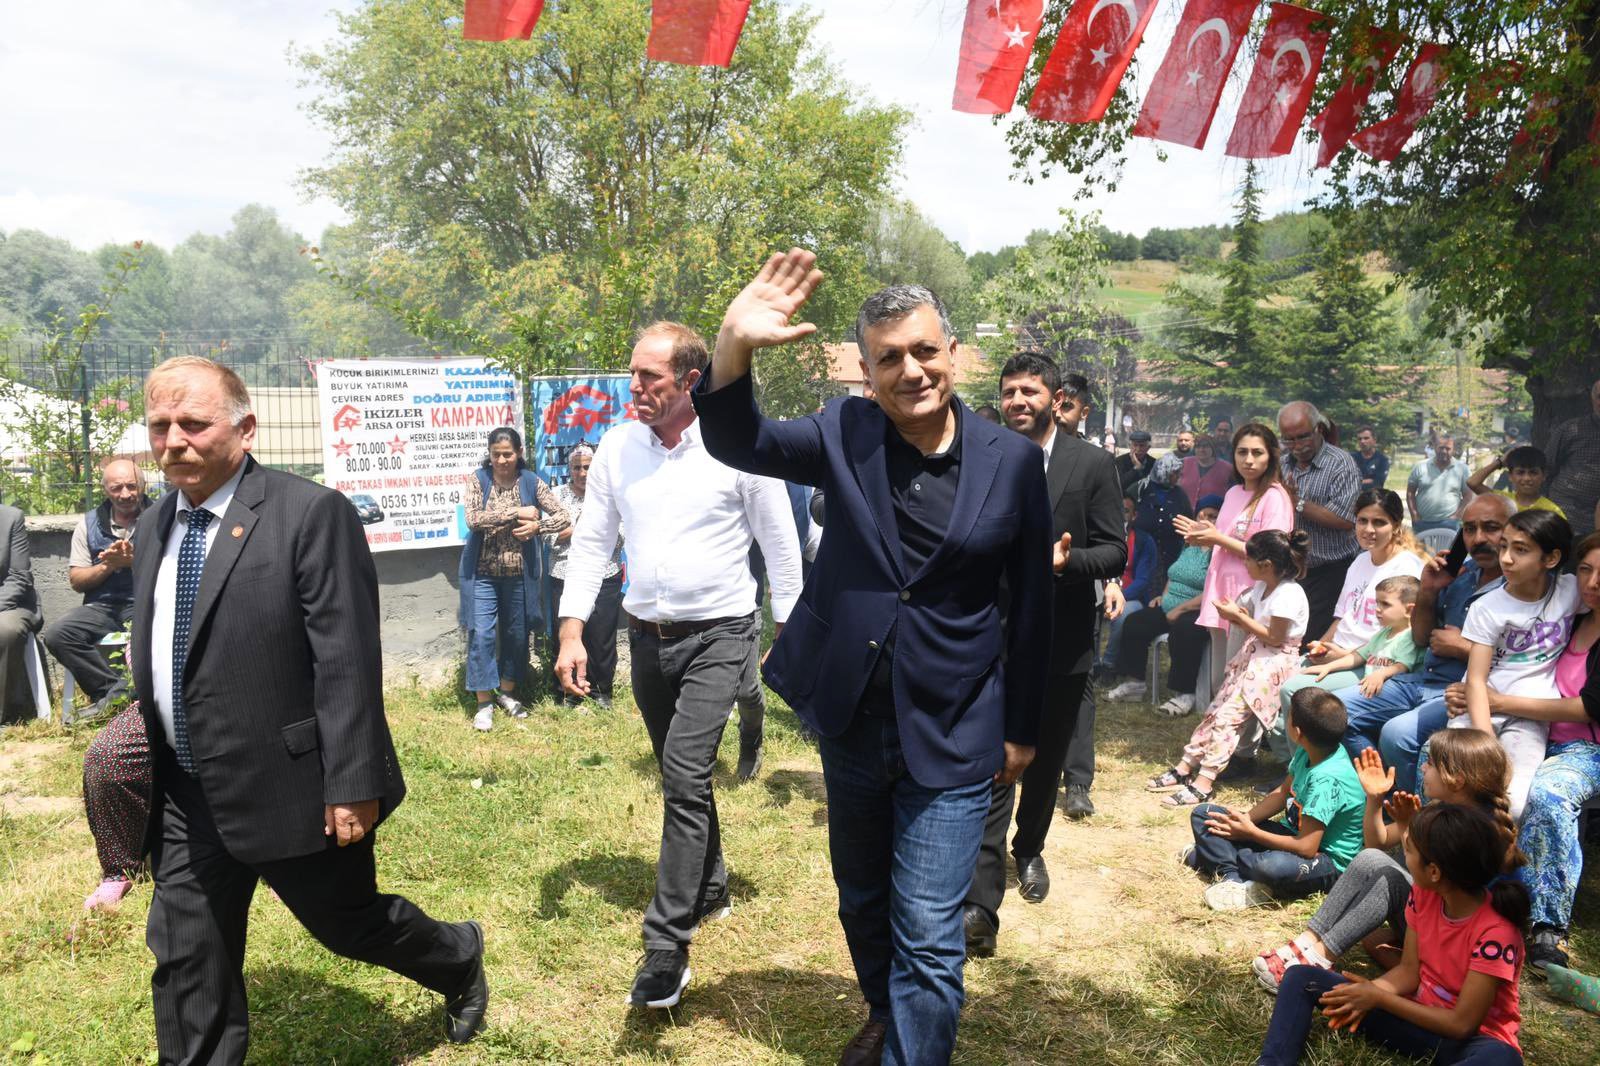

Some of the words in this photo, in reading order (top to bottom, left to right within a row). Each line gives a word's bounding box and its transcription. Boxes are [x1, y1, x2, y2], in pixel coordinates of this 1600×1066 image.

[366, 381, 408, 390] YATIRIMA
[444, 380, 514, 389] YATIRIMIN
[331, 394, 372, 404] ÇEVİREN
[374, 394, 404, 402] ADRES
[413, 393, 461, 404] DOĞRU
[364, 407, 423, 419] İKİZLER
[430, 405, 515, 428] KAMPANYA
[365, 422, 393, 430] ARSA
[439, 432, 455, 441] ARSA
[356, 441, 386, 455] 70.000
[346, 457, 370, 472] 80.00
[377, 456, 402, 471] 90.00
[357, 479, 382, 490] TAKAS
[412, 476, 422, 487] VE
[424, 475, 443, 487] VADE
[381, 494, 407, 509] 0536
[410, 493, 429, 507] 371
[433, 492, 445, 505] 66
[449, 490, 460, 504] 49
